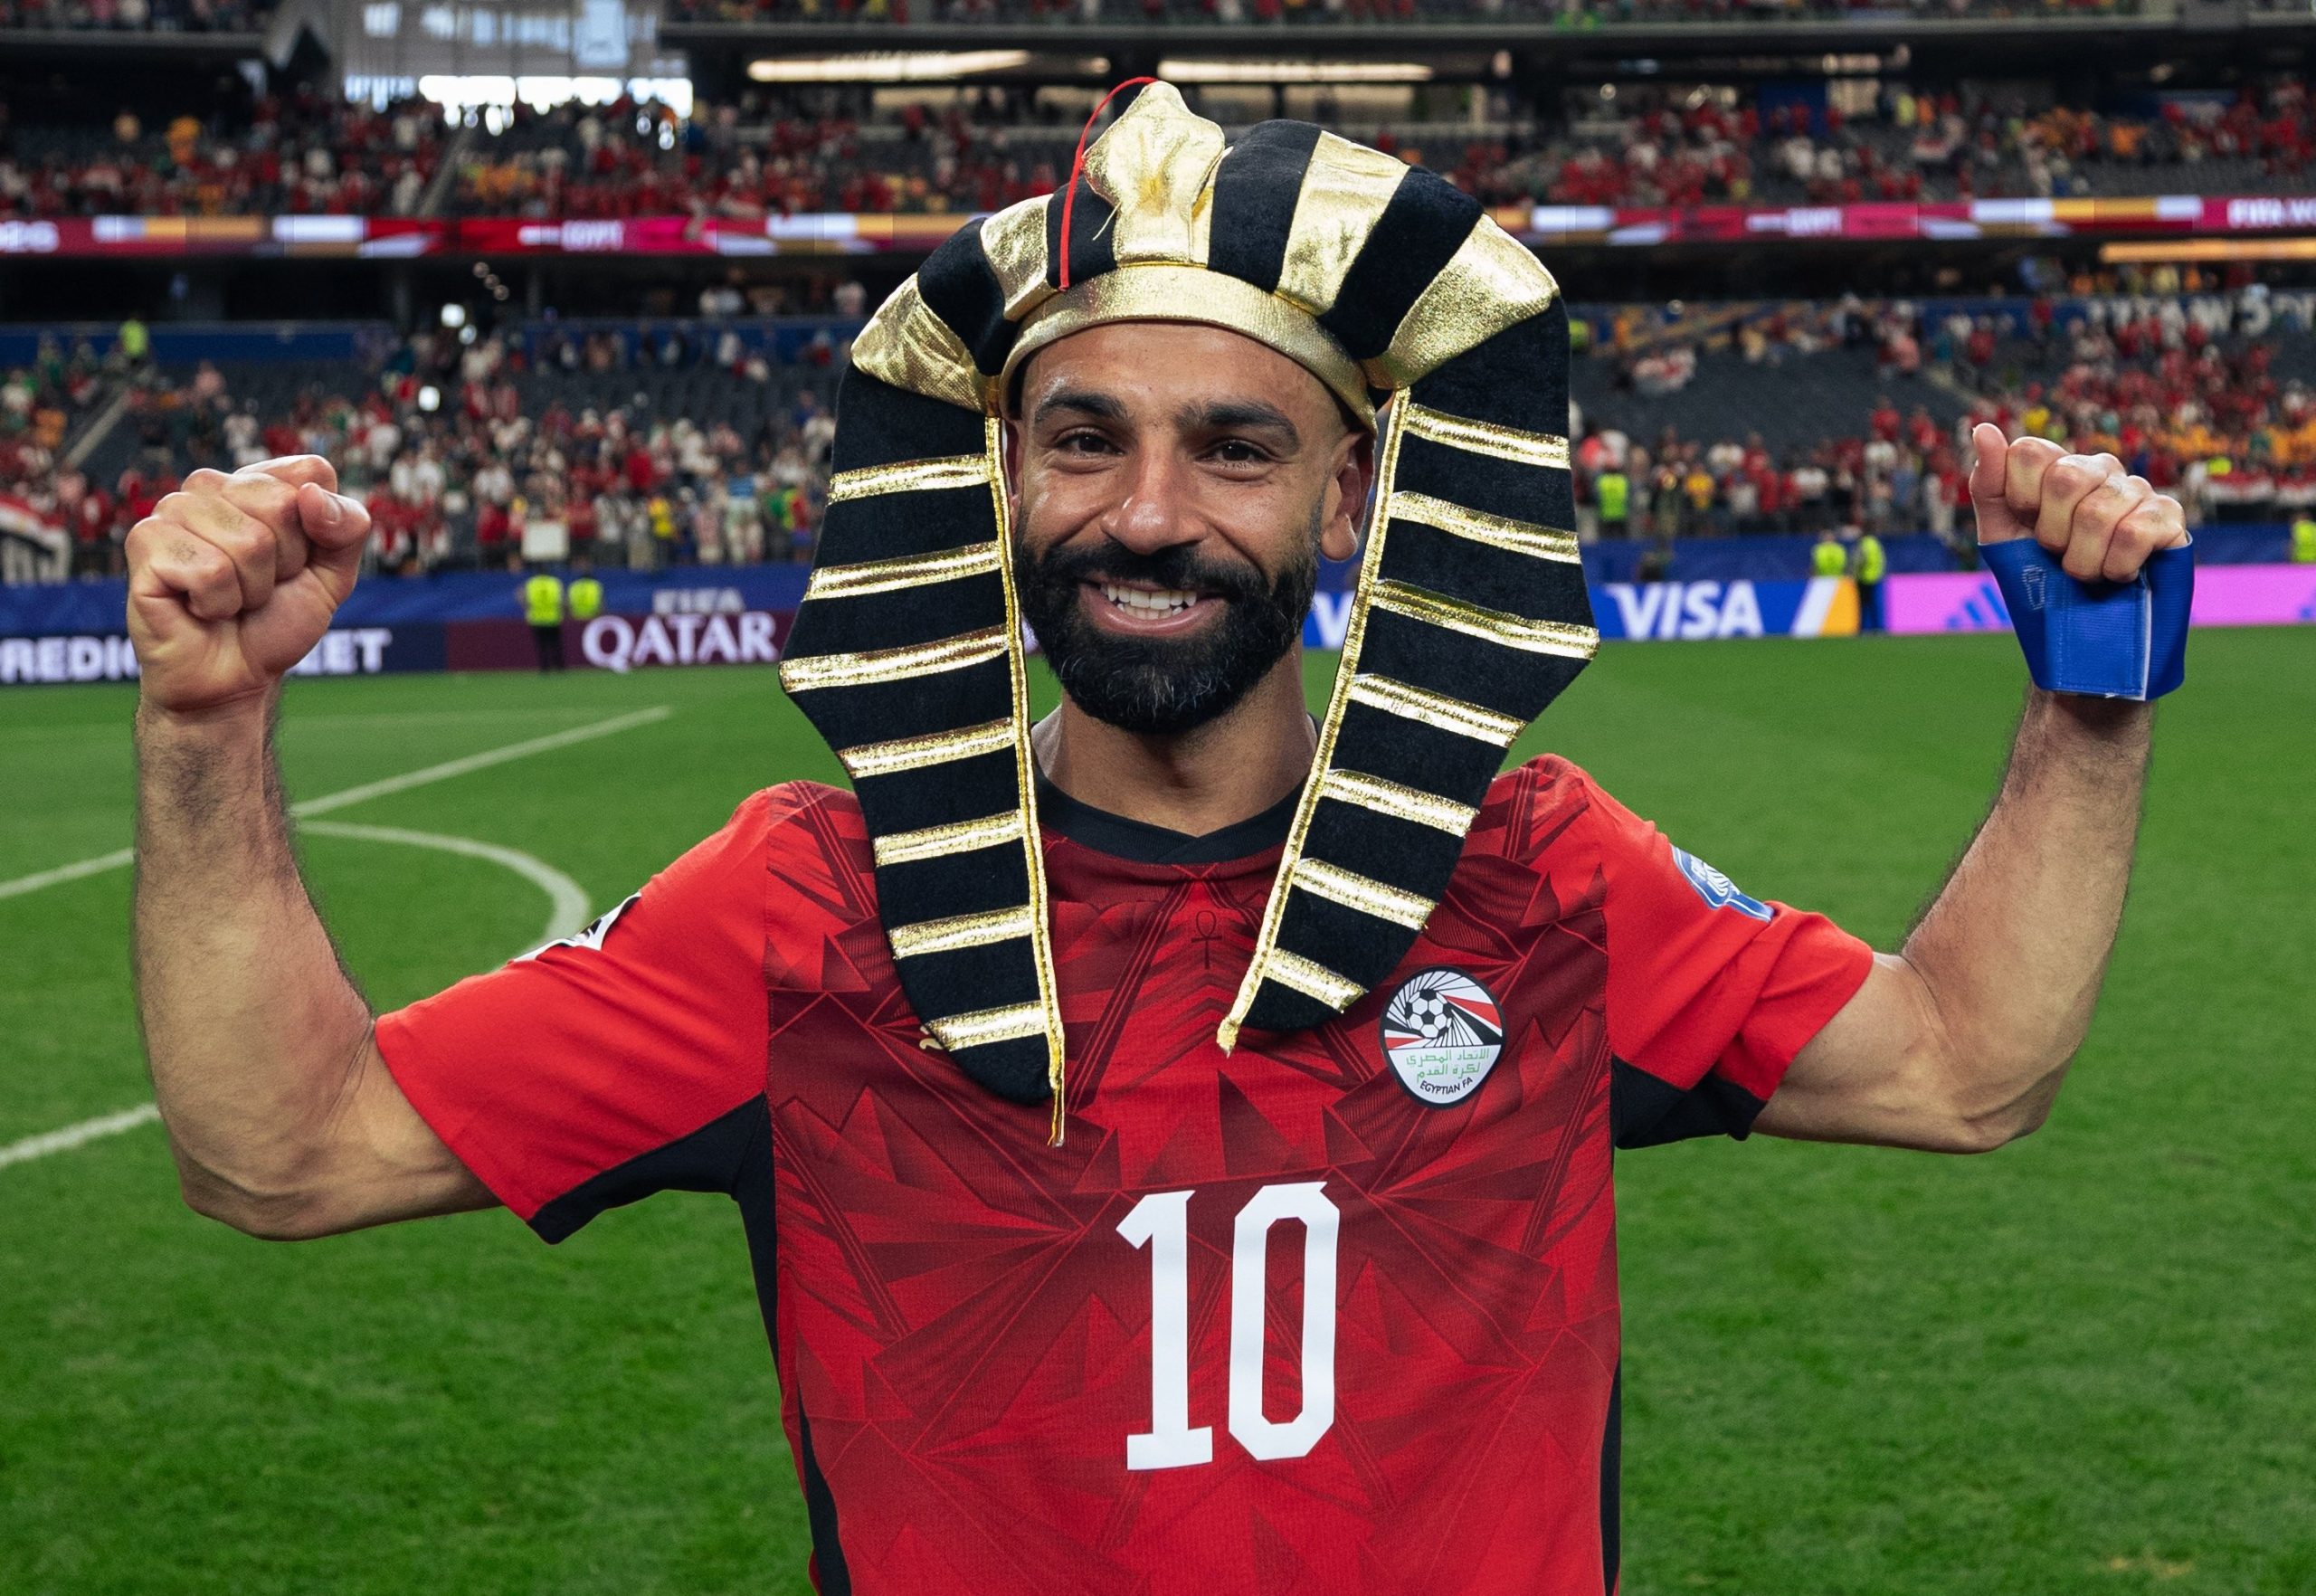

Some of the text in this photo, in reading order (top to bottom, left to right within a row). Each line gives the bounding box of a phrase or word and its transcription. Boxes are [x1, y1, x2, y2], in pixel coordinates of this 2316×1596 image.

[652, 588, 745, 614] FIFA
[1605, 580, 1764, 641] VISA
[582, 611, 779, 672] QATAR
[1457, 1048, 1490, 1061] الاتحاد
[1417, 1061, 1481, 1084] لكرة القدم
[1419, 1077, 1473, 1095] EGYPTIAN FA
[1115, 1182, 1340, 1470] 10
